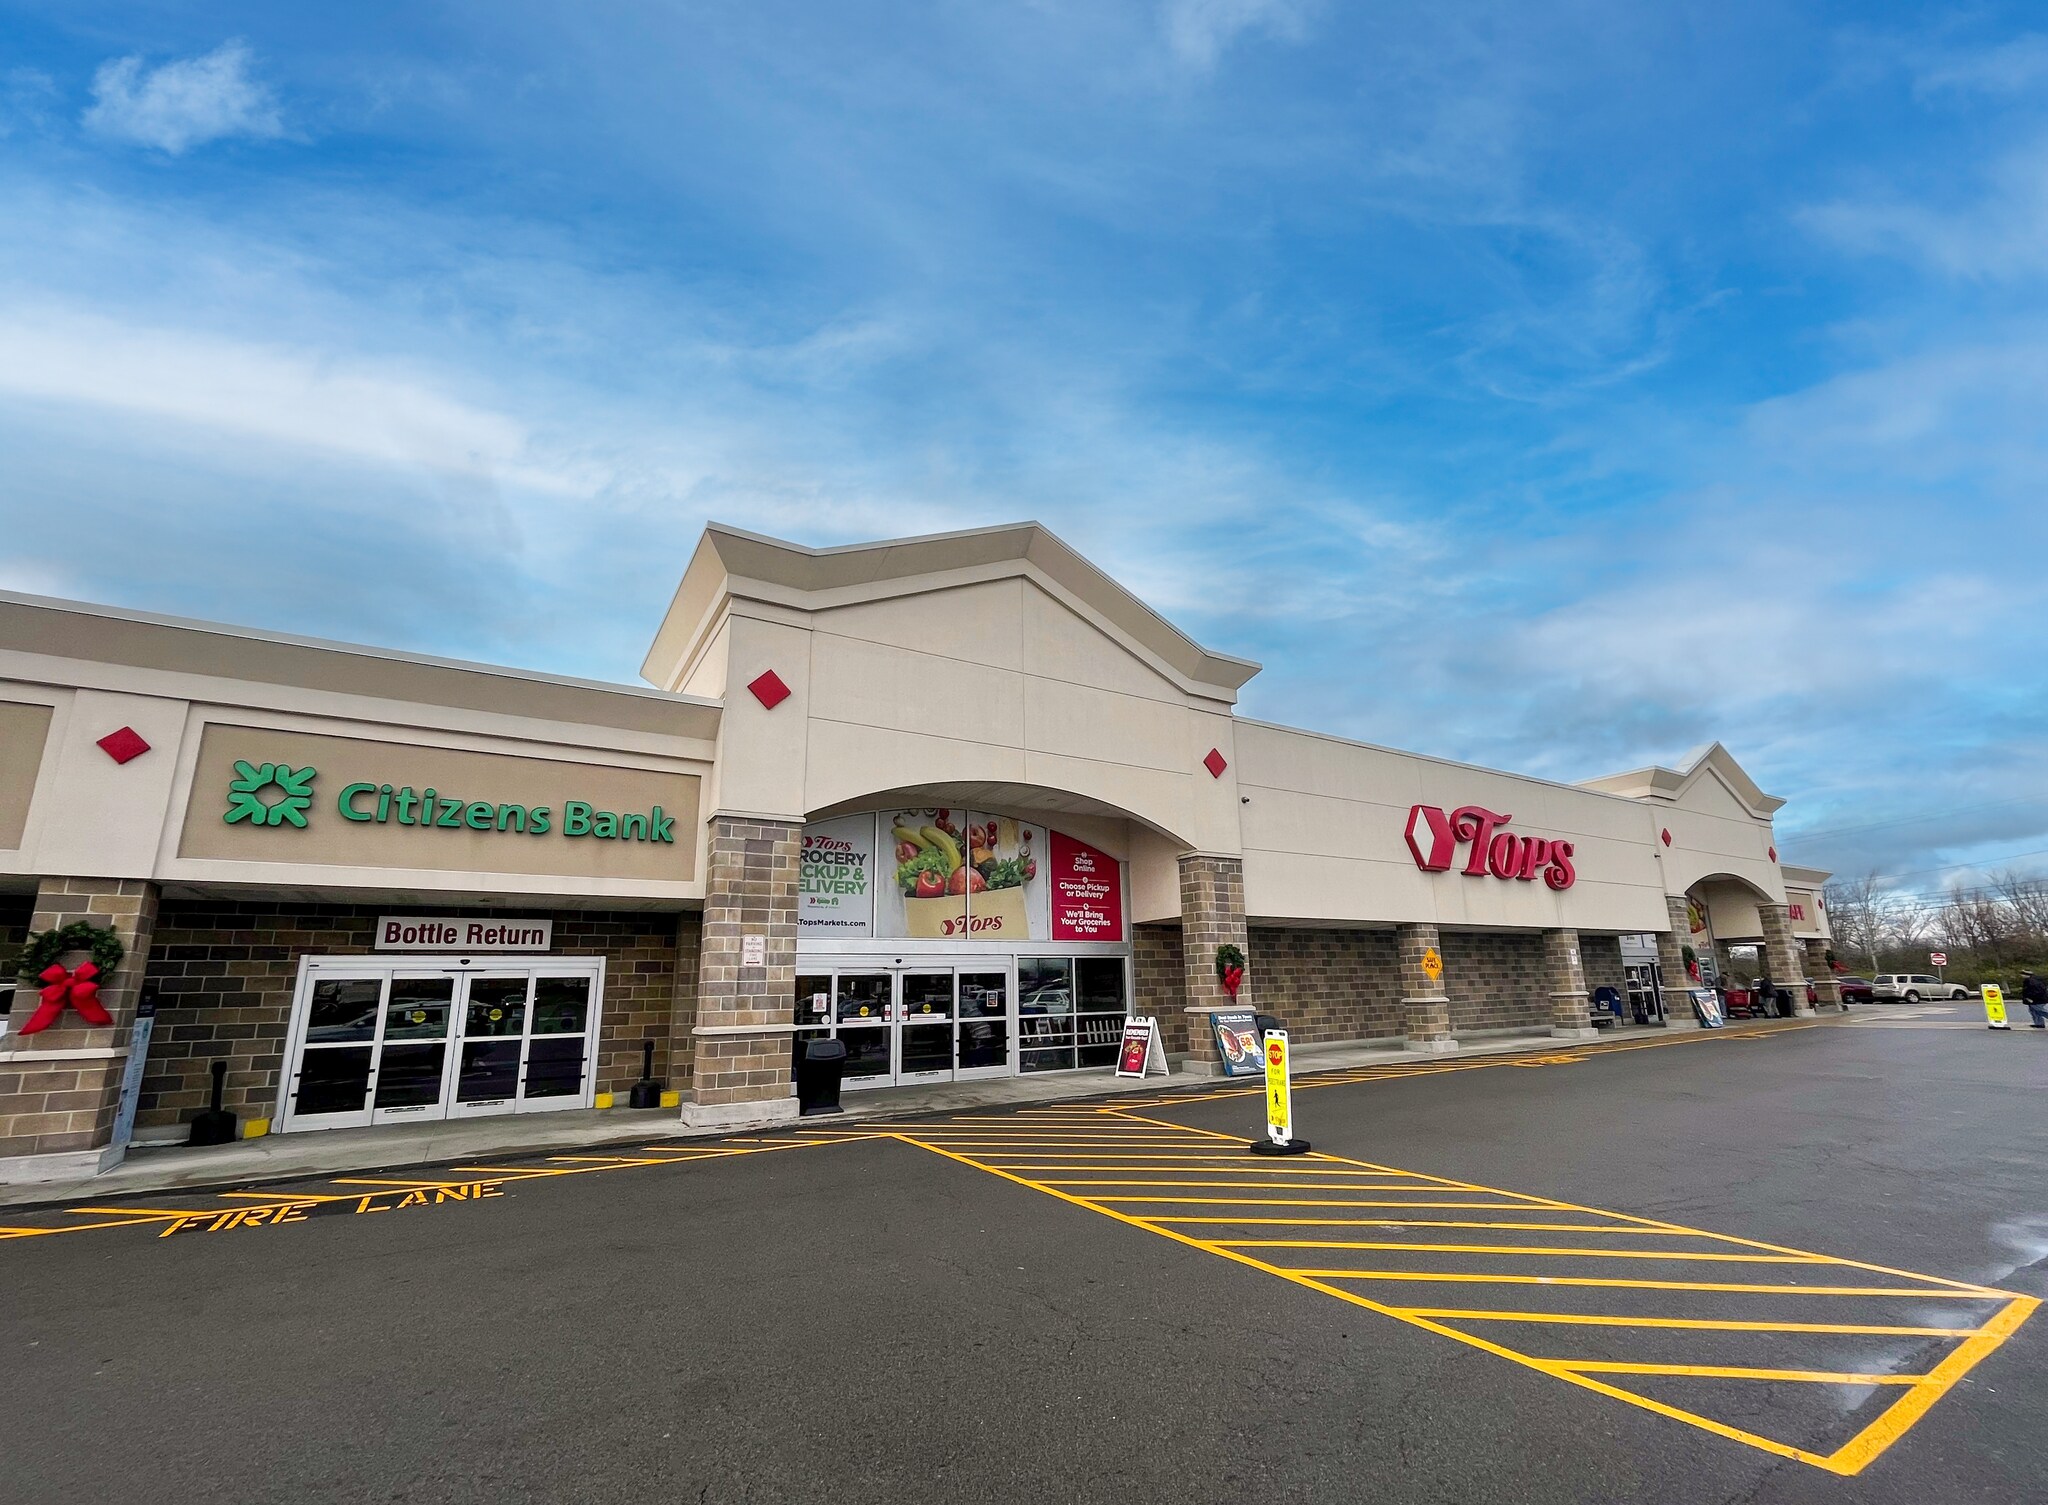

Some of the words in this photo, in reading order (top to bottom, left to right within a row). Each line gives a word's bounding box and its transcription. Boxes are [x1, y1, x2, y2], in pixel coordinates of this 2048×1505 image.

[338, 782, 551, 834] Citizens
[563, 801, 675, 843] Bank
[800, 849, 868, 866] ROCERY
[1074, 857, 1093, 866] Shop
[800, 864, 850, 880] CKUP
[853, 867, 865, 881] &
[1073, 864, 1095, 873] Online
[799, 878, 868, 895] ELIVERY
[1059, 882, 1086, 891] Choose
[1086, 883, 1110, 893] Pickup
[1075, 890, 1104, 900] Delivery
[1085, 911, 1104, 920] Bring
[1060, 917, 1078, 926] Your
[1078, 918, 1111, 927] Groceries
[384, 921, 458, 944] Bottle
[466, 923, 544, 945] Return
[1268, 1050, 1283, 1060] STOP
[158, 1203, 318, 1238] FIRE
[355, 1182, 505, 1215] LANE
